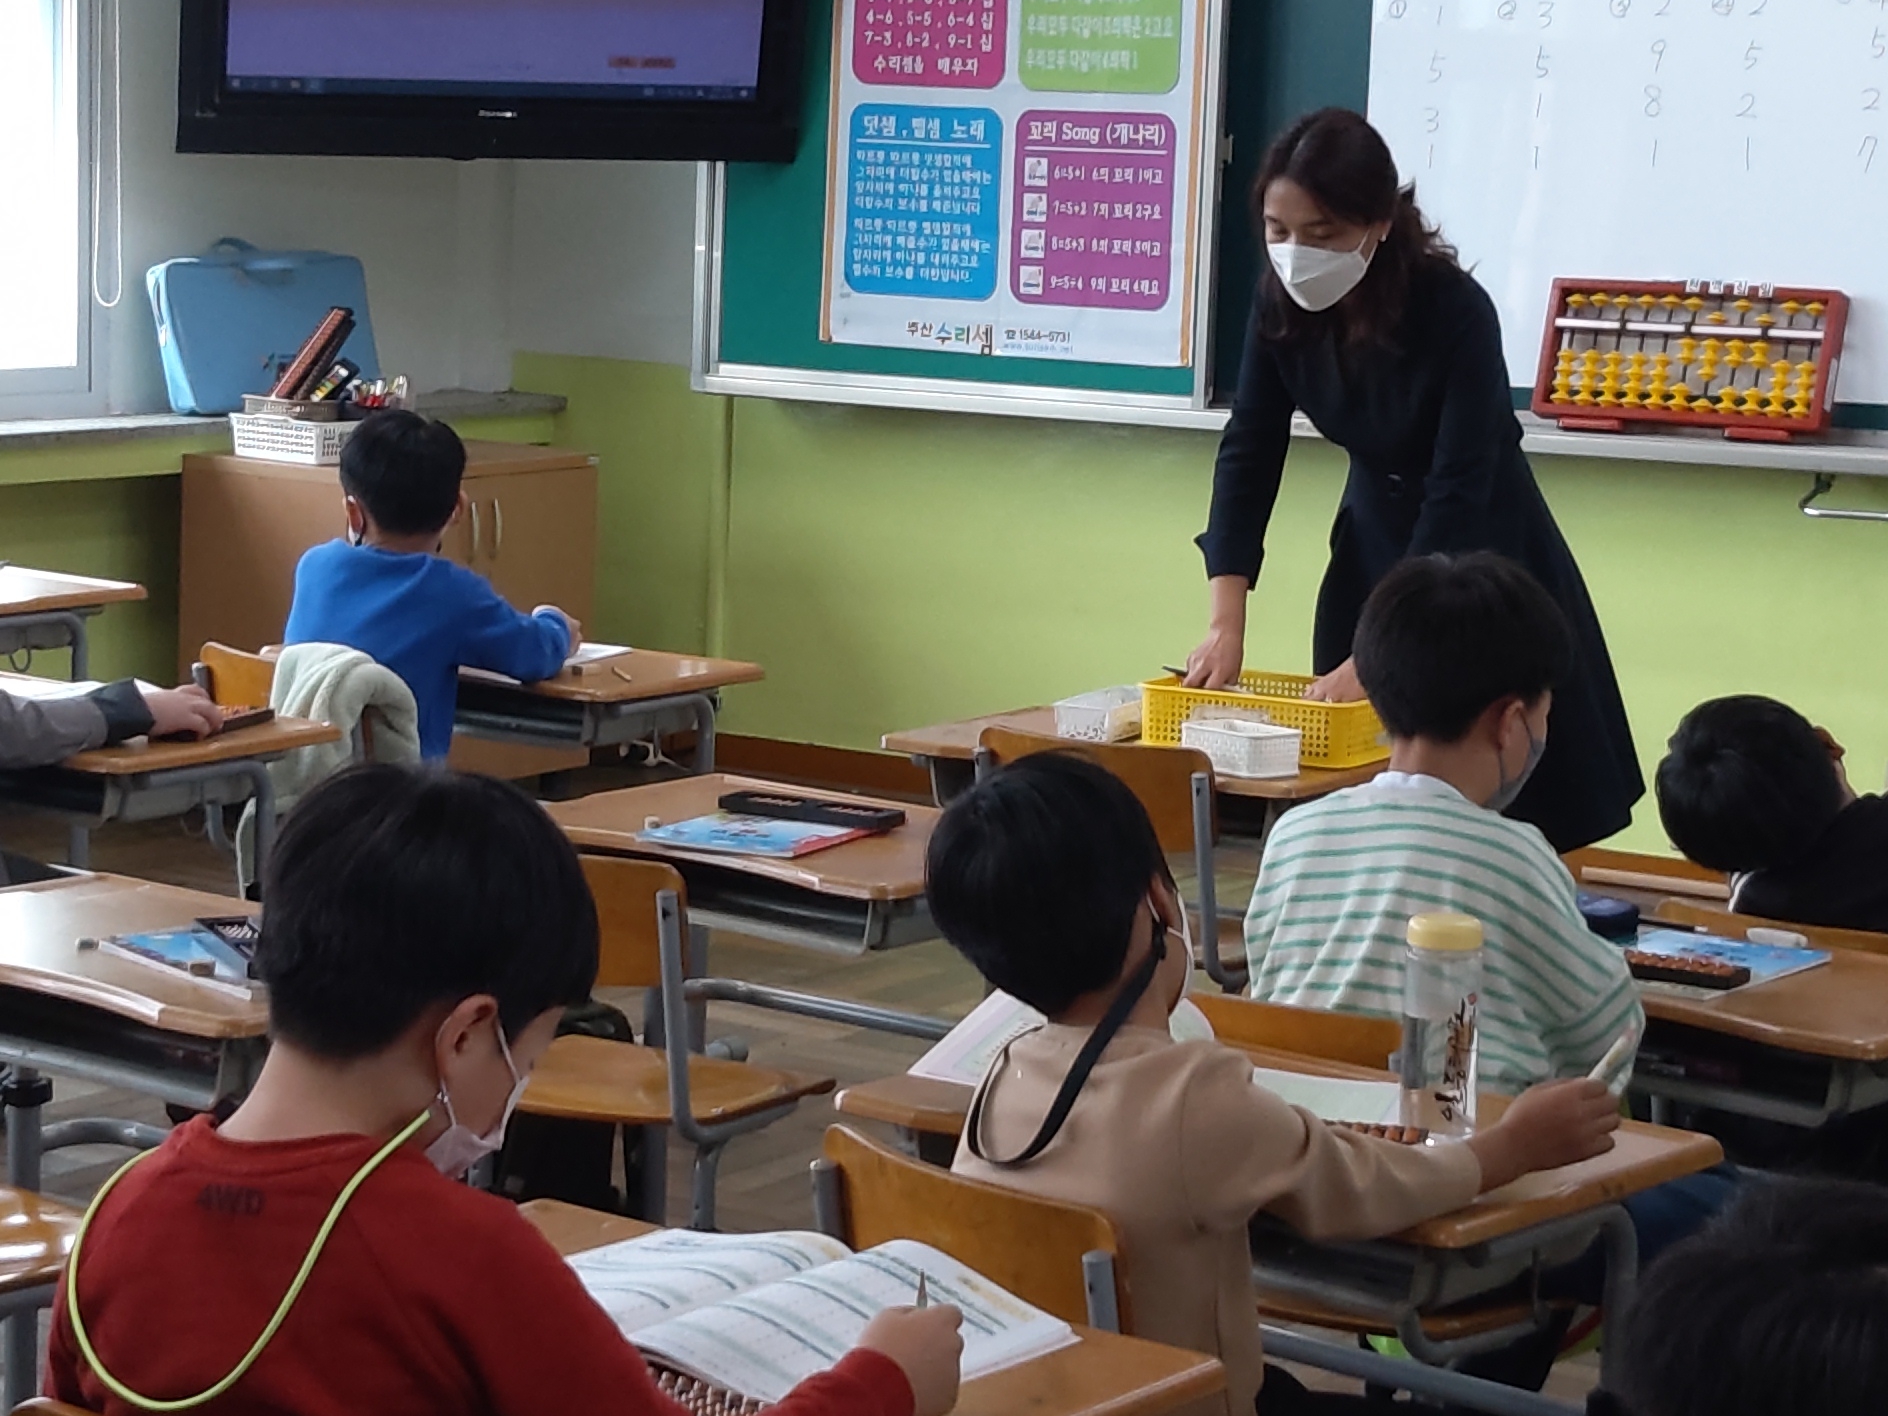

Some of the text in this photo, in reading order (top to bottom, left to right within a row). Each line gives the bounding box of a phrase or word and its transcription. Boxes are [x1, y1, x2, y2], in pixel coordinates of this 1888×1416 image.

[1871, 26, 1887, 58] 5
[1861, 88, 1880, 111] 2
[1062, 122, 1100, 145] Song
[1858, 135, 1878, 173] 7
